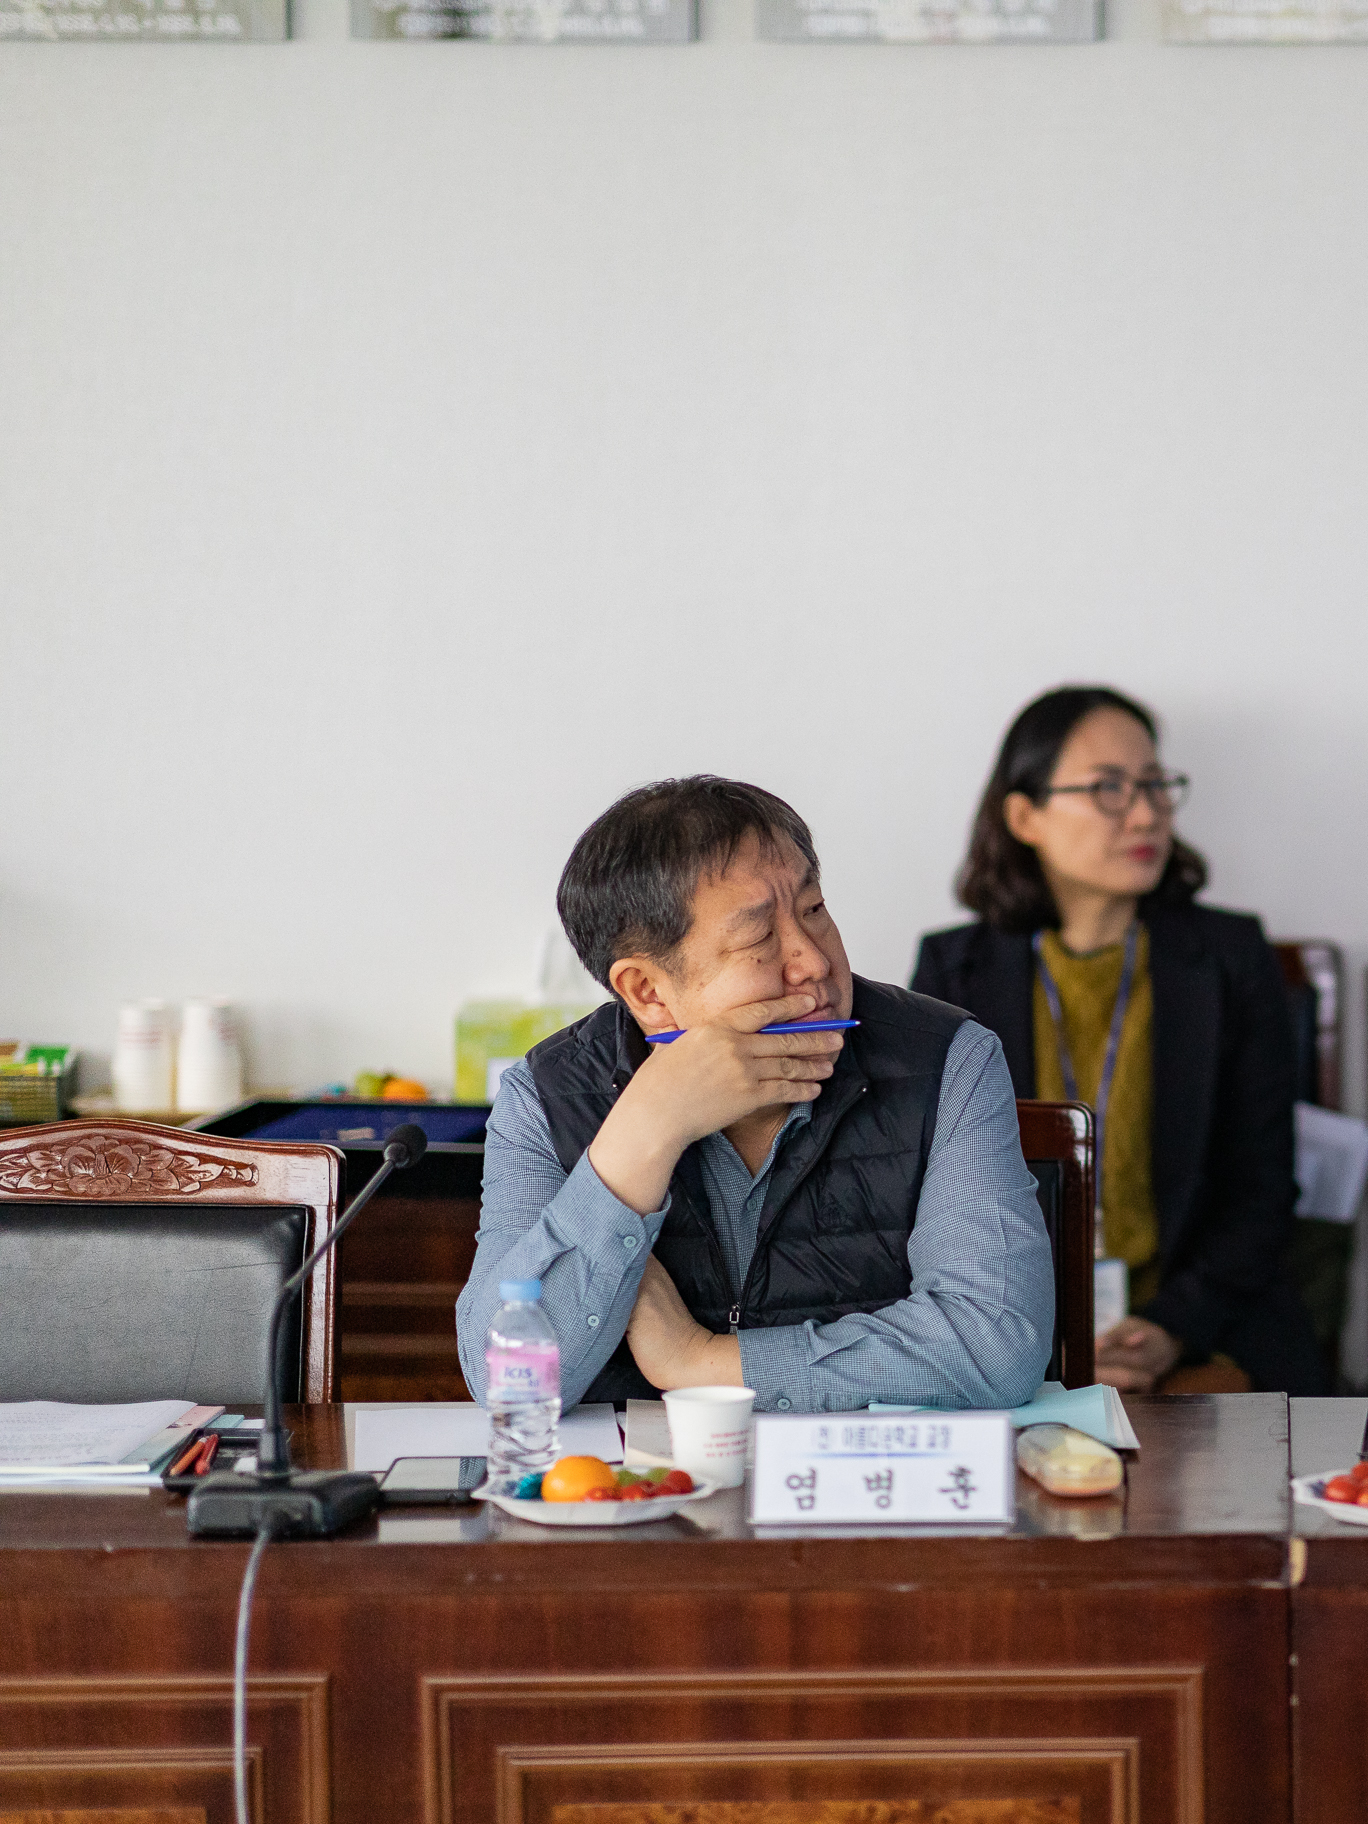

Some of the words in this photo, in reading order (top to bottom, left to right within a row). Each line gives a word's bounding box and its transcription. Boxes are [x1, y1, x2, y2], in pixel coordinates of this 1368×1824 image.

[785, 1466, 818, 1512] 염
[863, 1467, 895, 1510] 병
[937, 1465, 979, 1511] 훈
